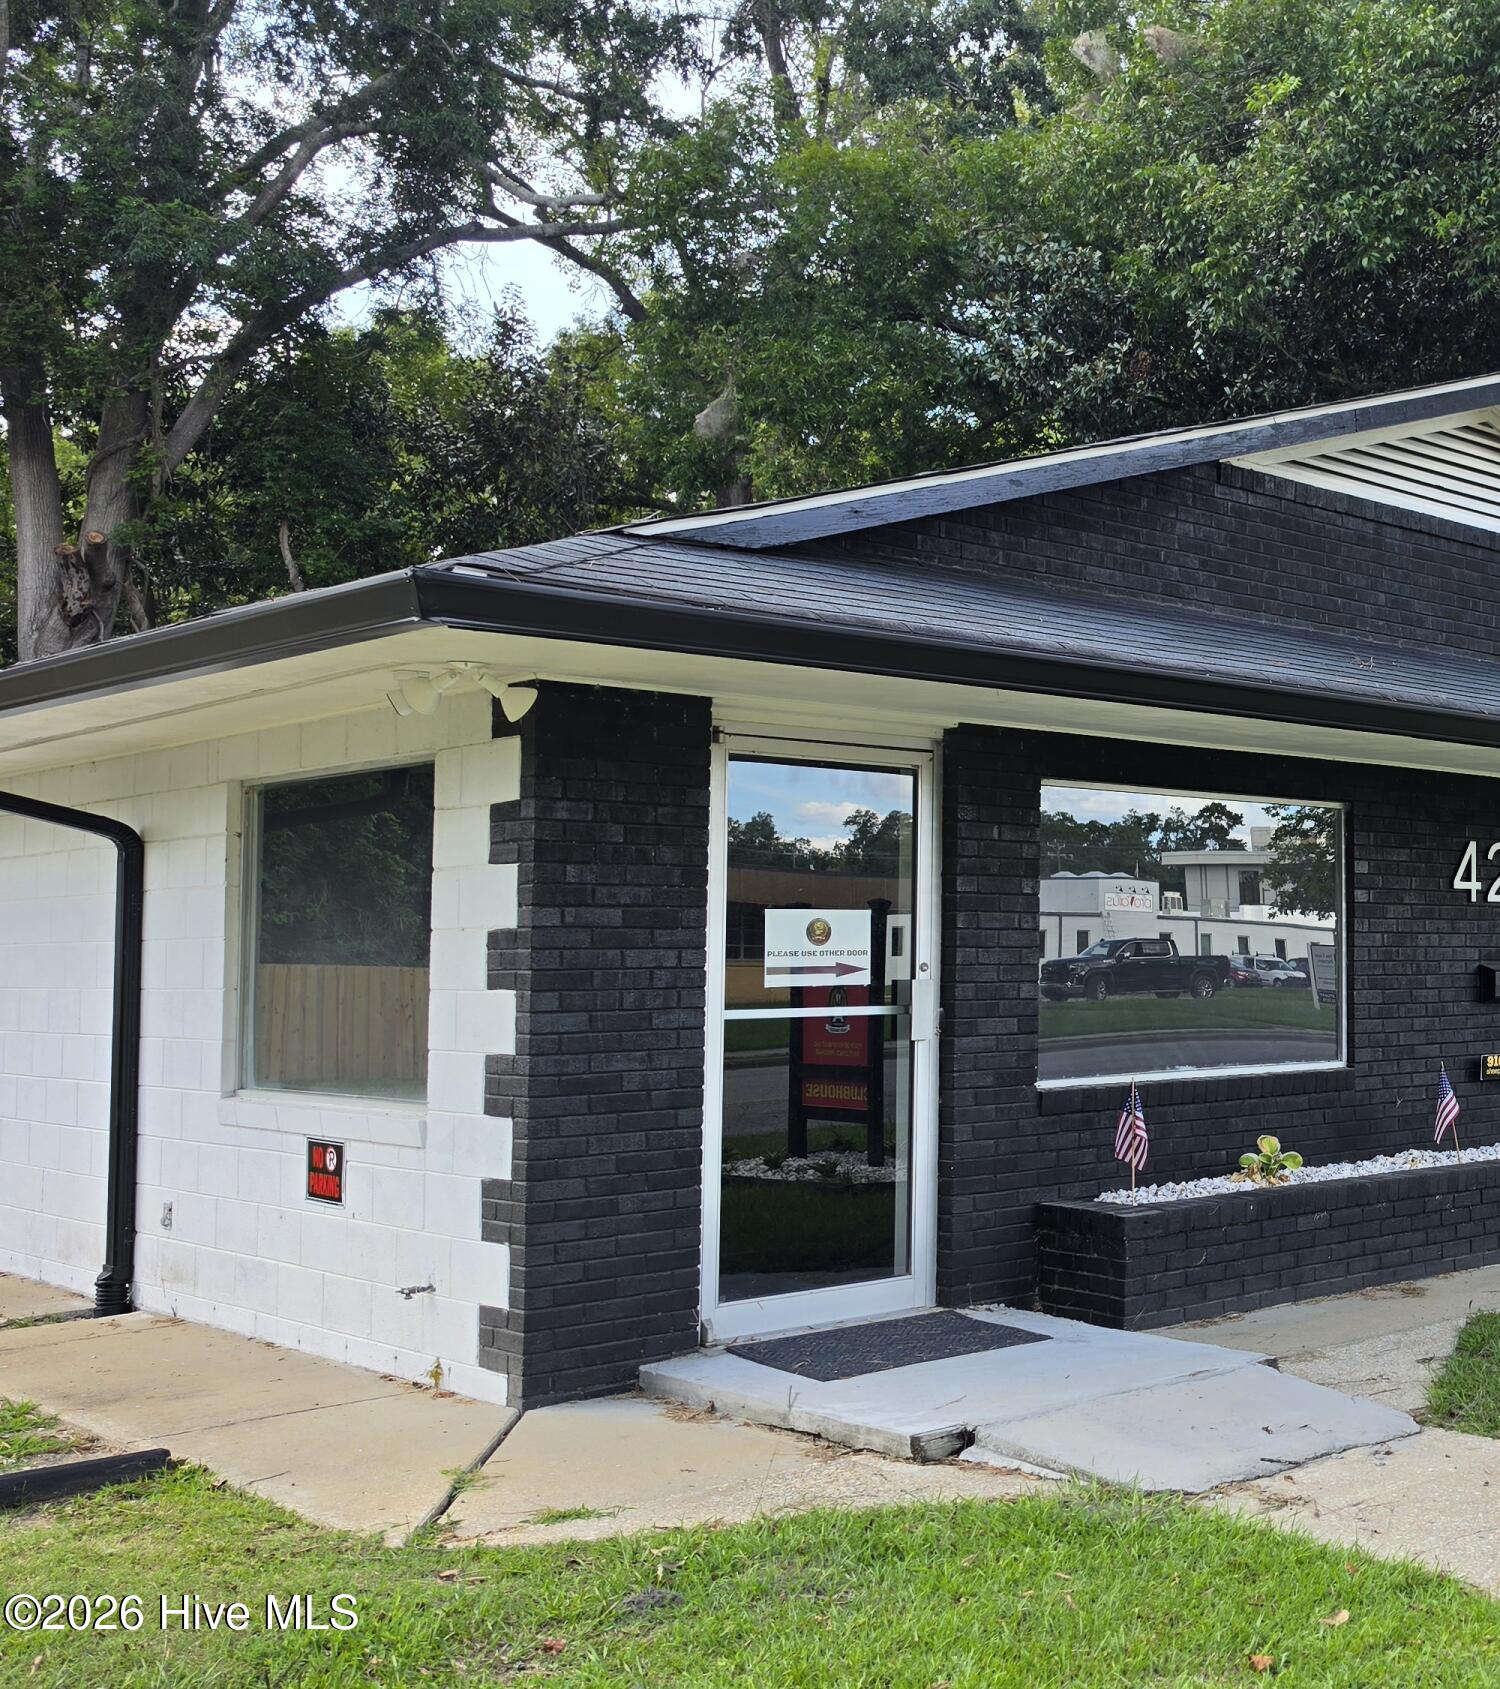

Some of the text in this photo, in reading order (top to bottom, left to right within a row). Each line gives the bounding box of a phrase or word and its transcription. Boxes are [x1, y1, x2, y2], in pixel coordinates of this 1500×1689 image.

[767, 950, 800, 958] PLEASE
[819, 949, 846, 957] OTHER
[846, 949, 869, 957] DOOR
[312, 1146, 324, 1169] NO
[309, 1171, 340, 1198] PARKING
